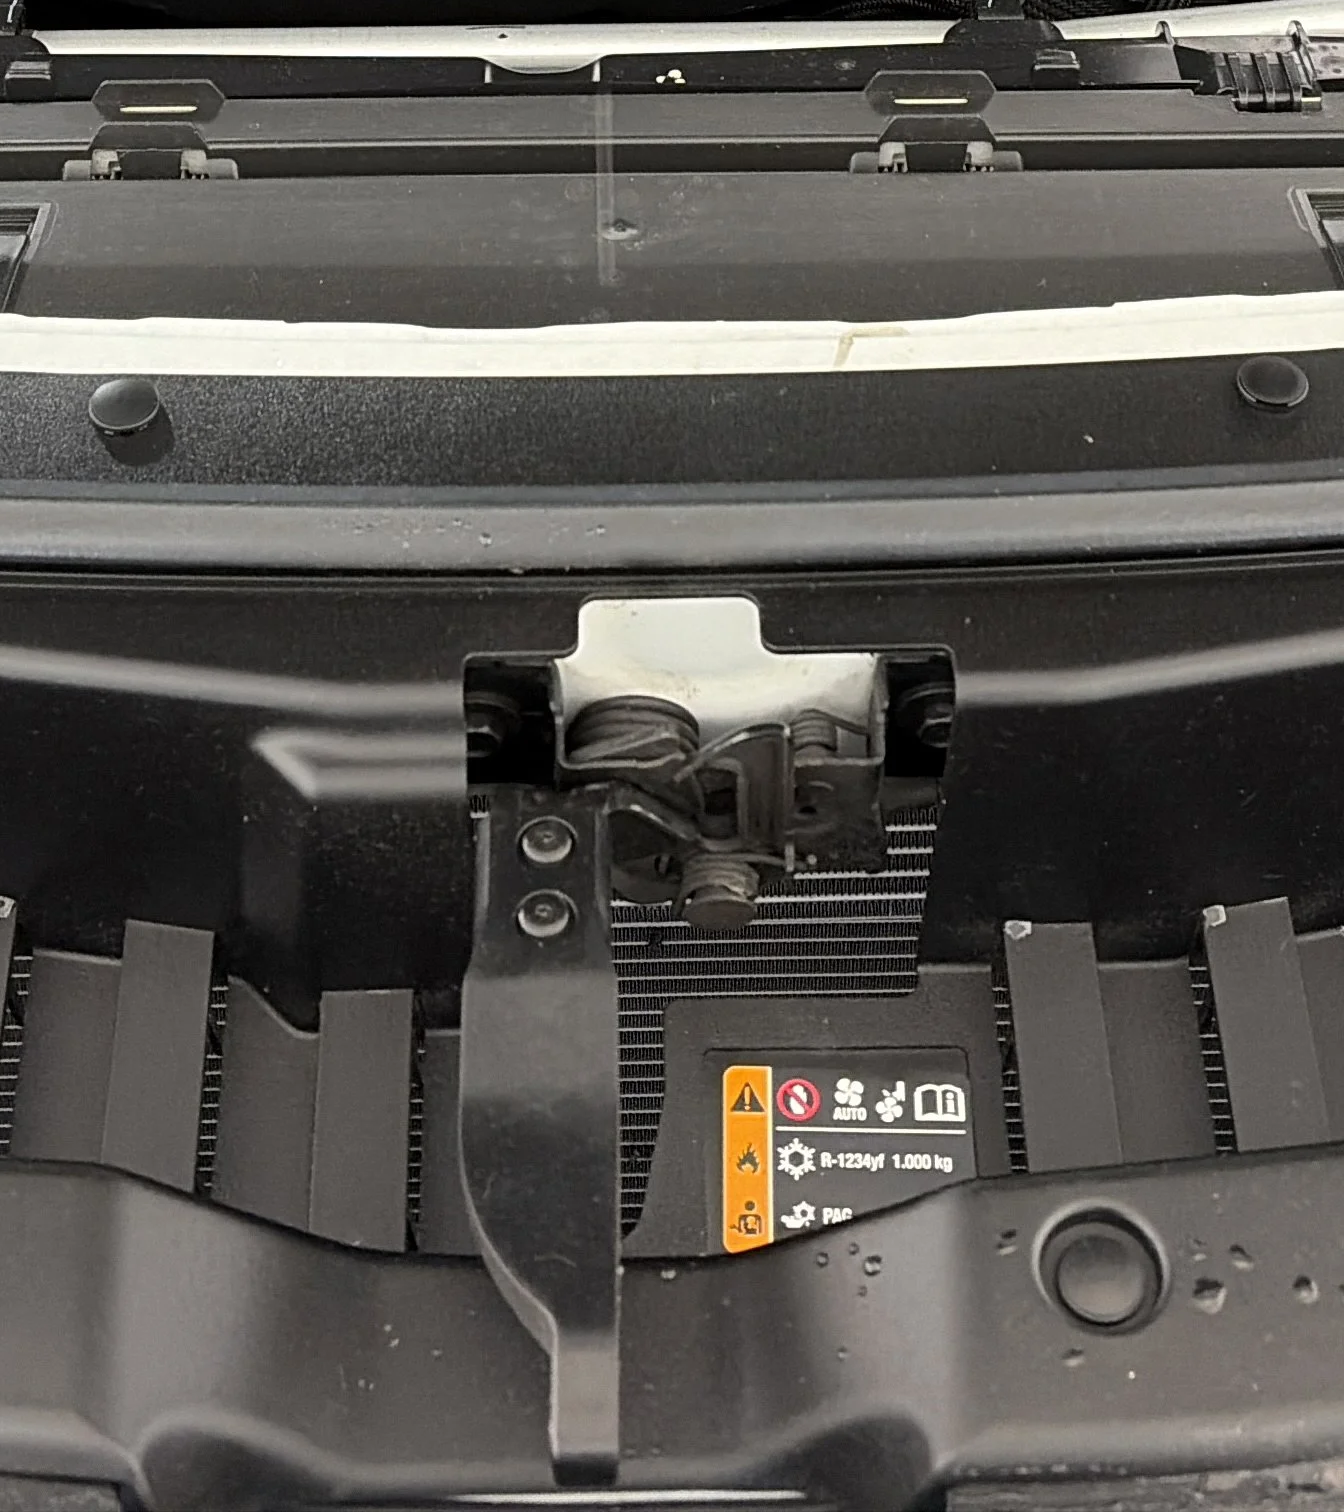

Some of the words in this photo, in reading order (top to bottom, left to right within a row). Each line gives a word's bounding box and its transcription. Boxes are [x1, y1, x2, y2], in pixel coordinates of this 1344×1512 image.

[832, 1106, 868, 1121] AUTO
[820, 1152, 885, 1172] R-1234yf
[892, 1153, 932, 1170] 1.000
[934, 1153, 953, 1173] kg
